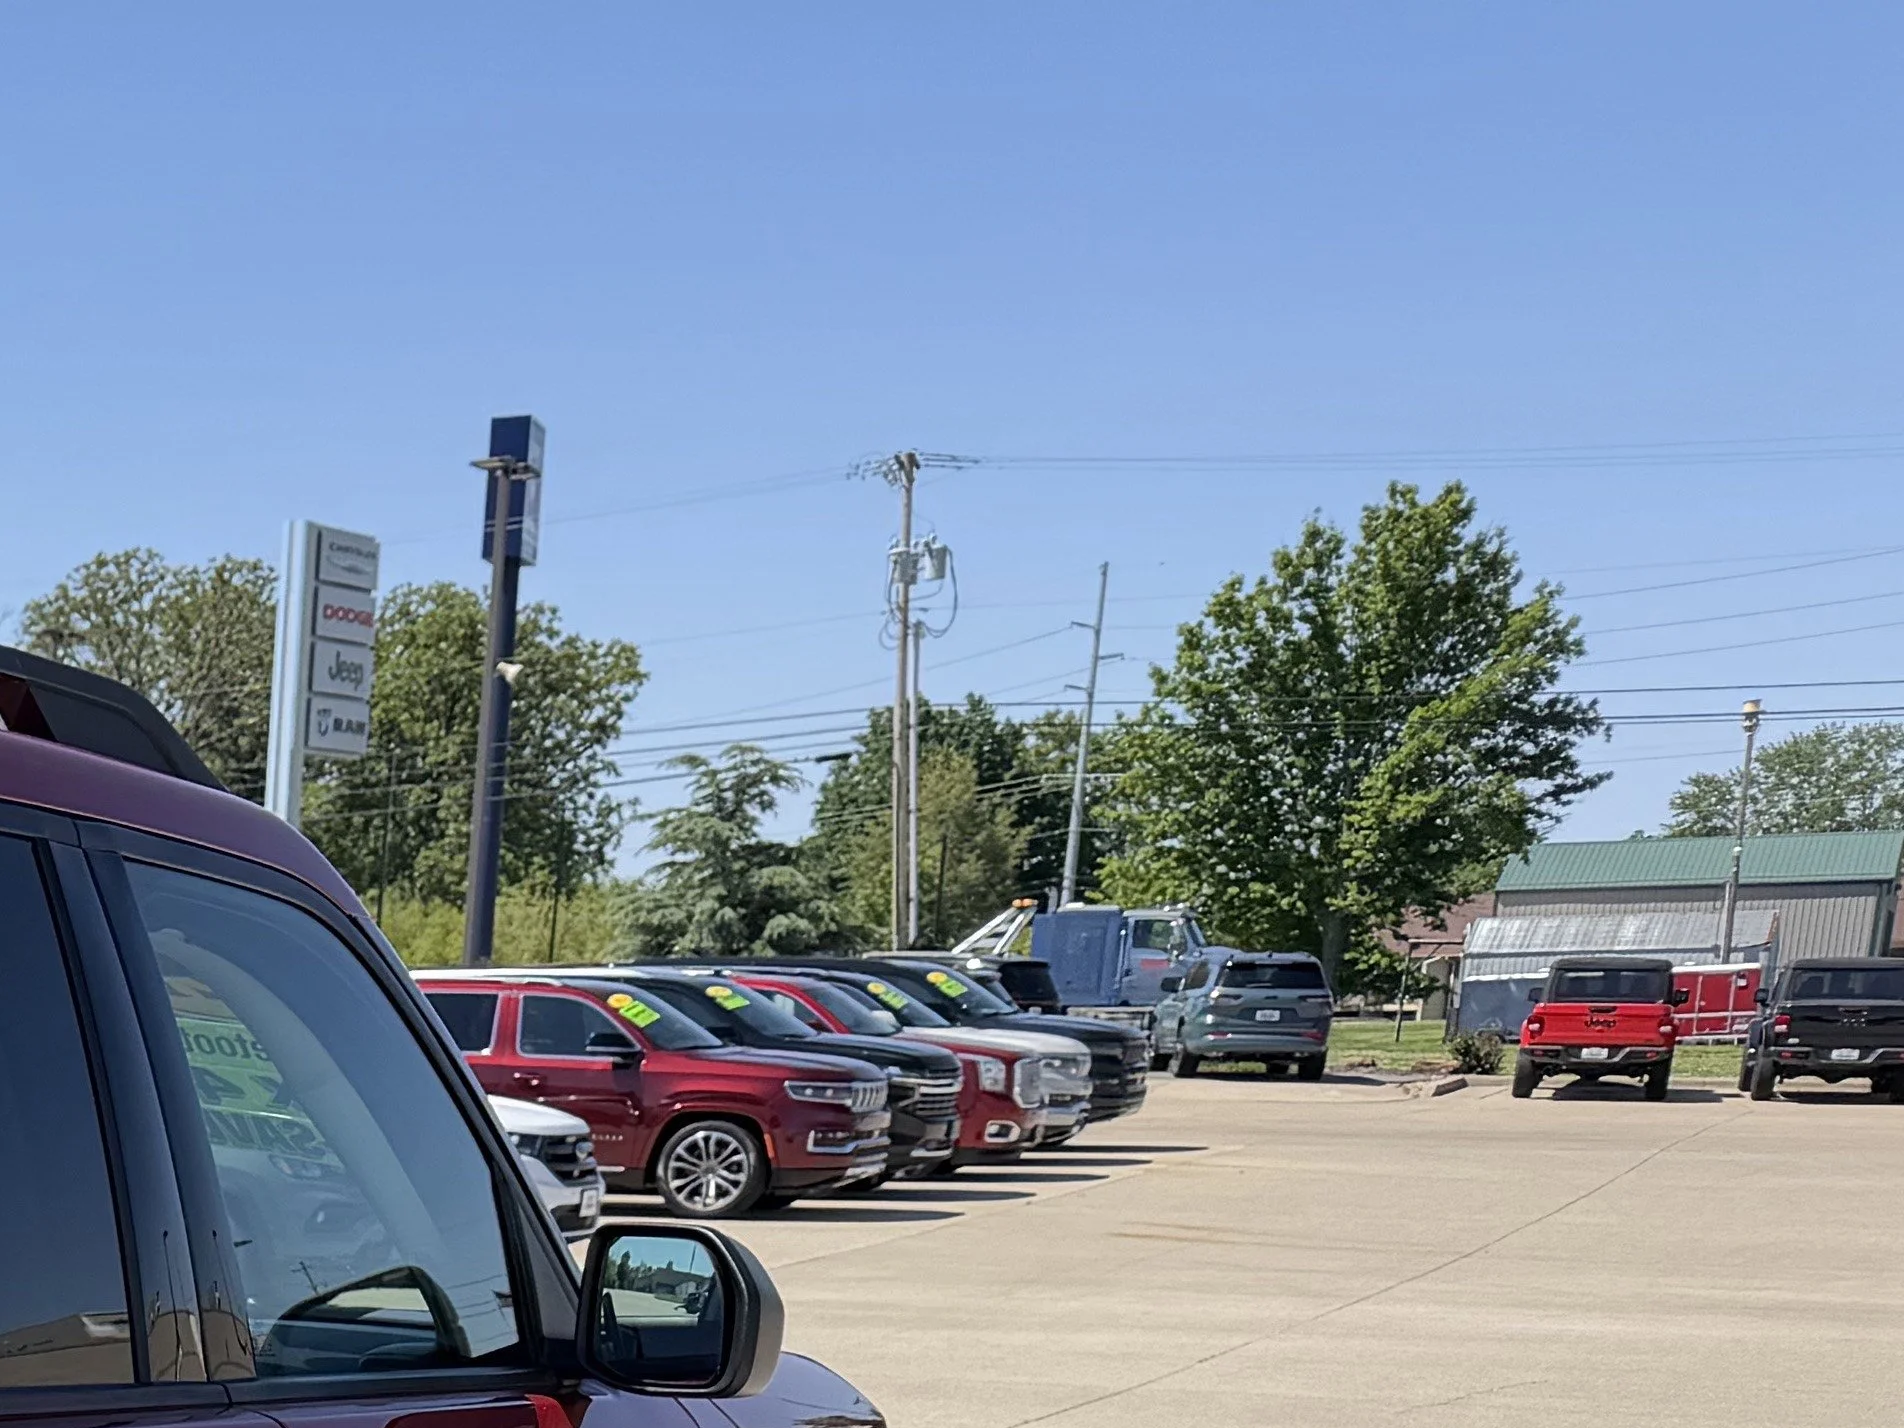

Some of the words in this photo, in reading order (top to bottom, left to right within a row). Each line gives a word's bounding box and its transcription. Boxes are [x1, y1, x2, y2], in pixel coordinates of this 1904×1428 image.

[323, 604, 373, 628] DODGE
[328, 649, 364, 690] Jeep
[334, 717, 366, 735] RAM
